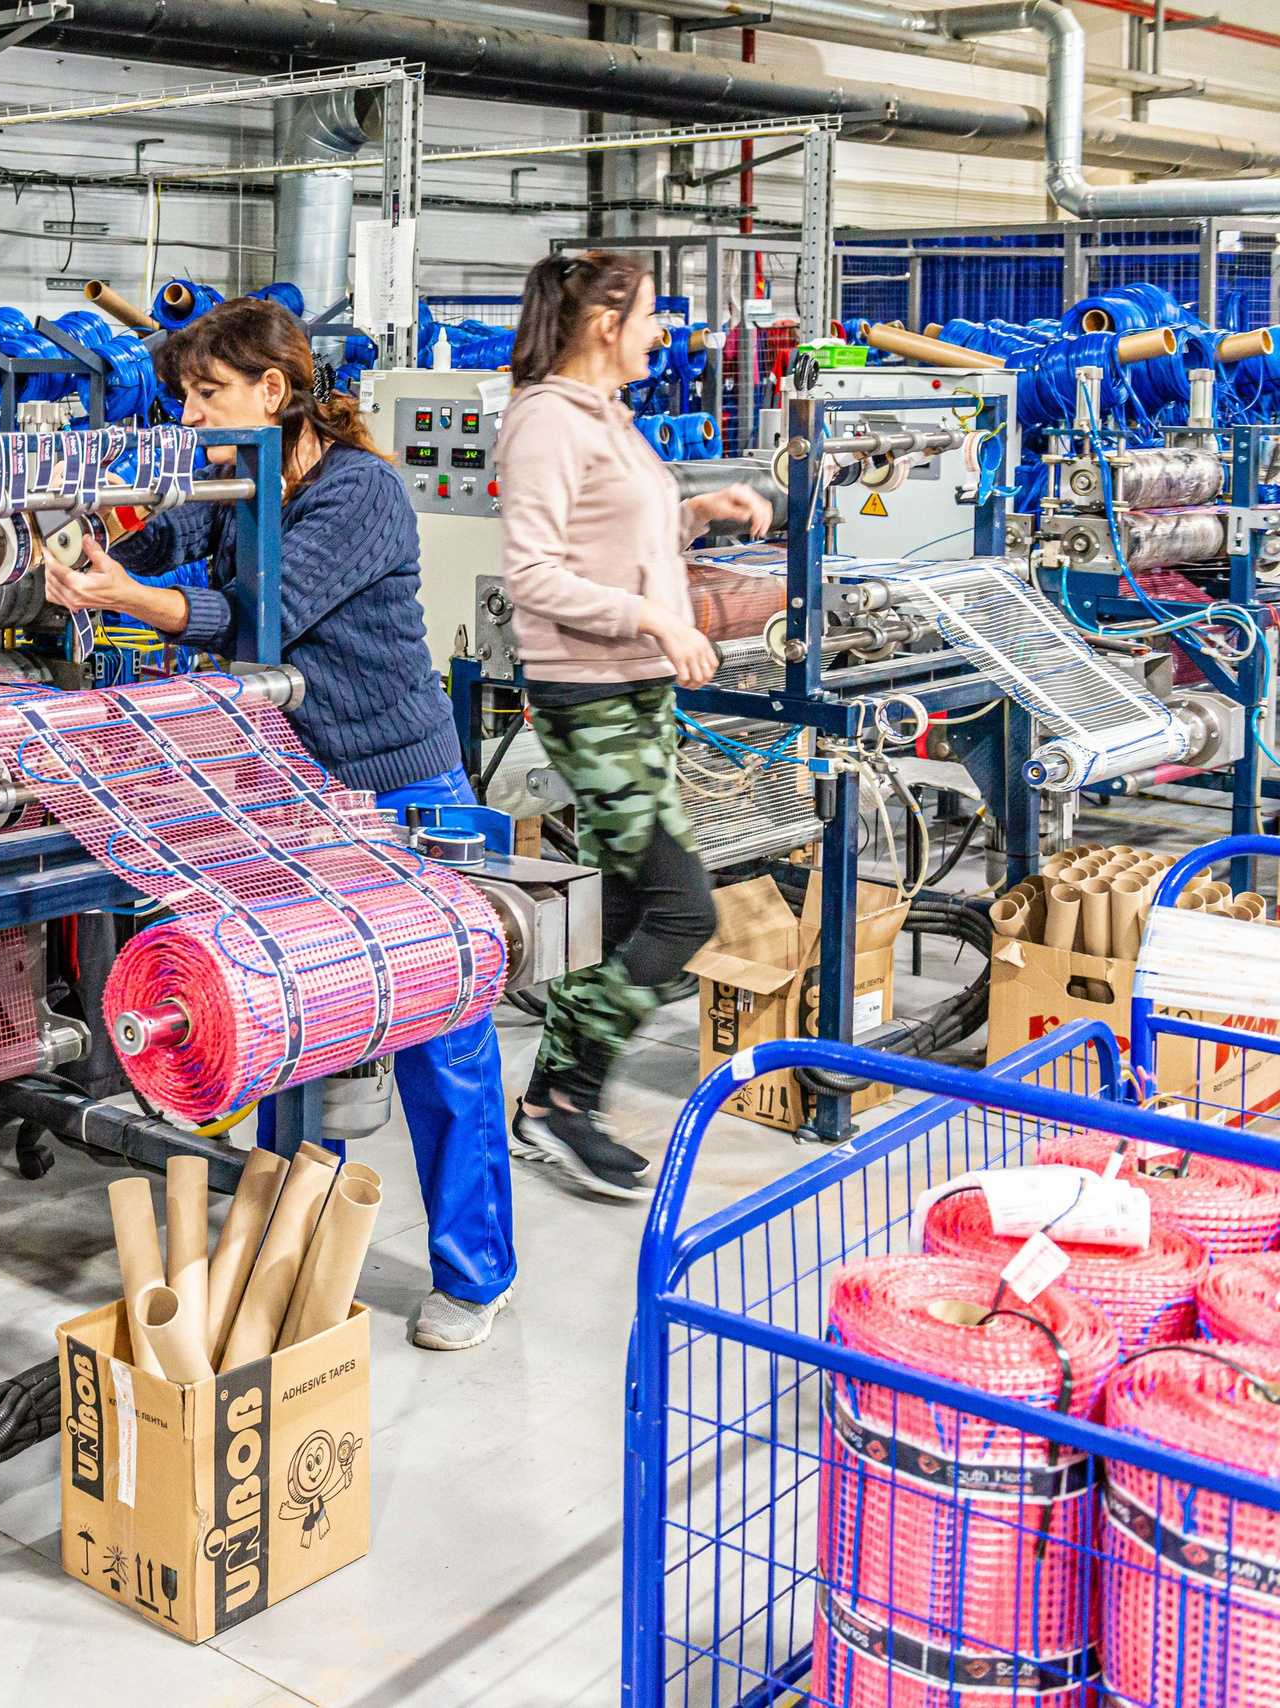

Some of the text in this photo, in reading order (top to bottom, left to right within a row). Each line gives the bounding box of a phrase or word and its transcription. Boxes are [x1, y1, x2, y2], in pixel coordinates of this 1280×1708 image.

[43, 440, 51, 461] Heat
[68, 435, 78, 456] Heat
[184, 430, 194, 450] Heat
[16, 453, 24, 474] Heat
[90, 443, 98, 464] Heat
[54, 744, 72, 762] South
[147, 729, 182, 763] South Heat
[247, 733, 281, 766] South Heat
[111, 806, 148, 840] South Heat
[221, 805, 259, 838] South Heat
[382, 813, 396, 823] South
[195, 877, 236, 908] South Heat
[306, 876, 345, 909] South Heat
[406, 877, 446, 909] South Heat
[461, 976, 469, 999] Heat
[286, 990, 297, 1018] South
[378, 997, 387, 1024] South
[282, 1359, 356, 1402] ADHESIVE TAPES
[141, 1411, 168, 1429] ЛЕНТЫ
[994, 1469, 1034, 1484] Heat
